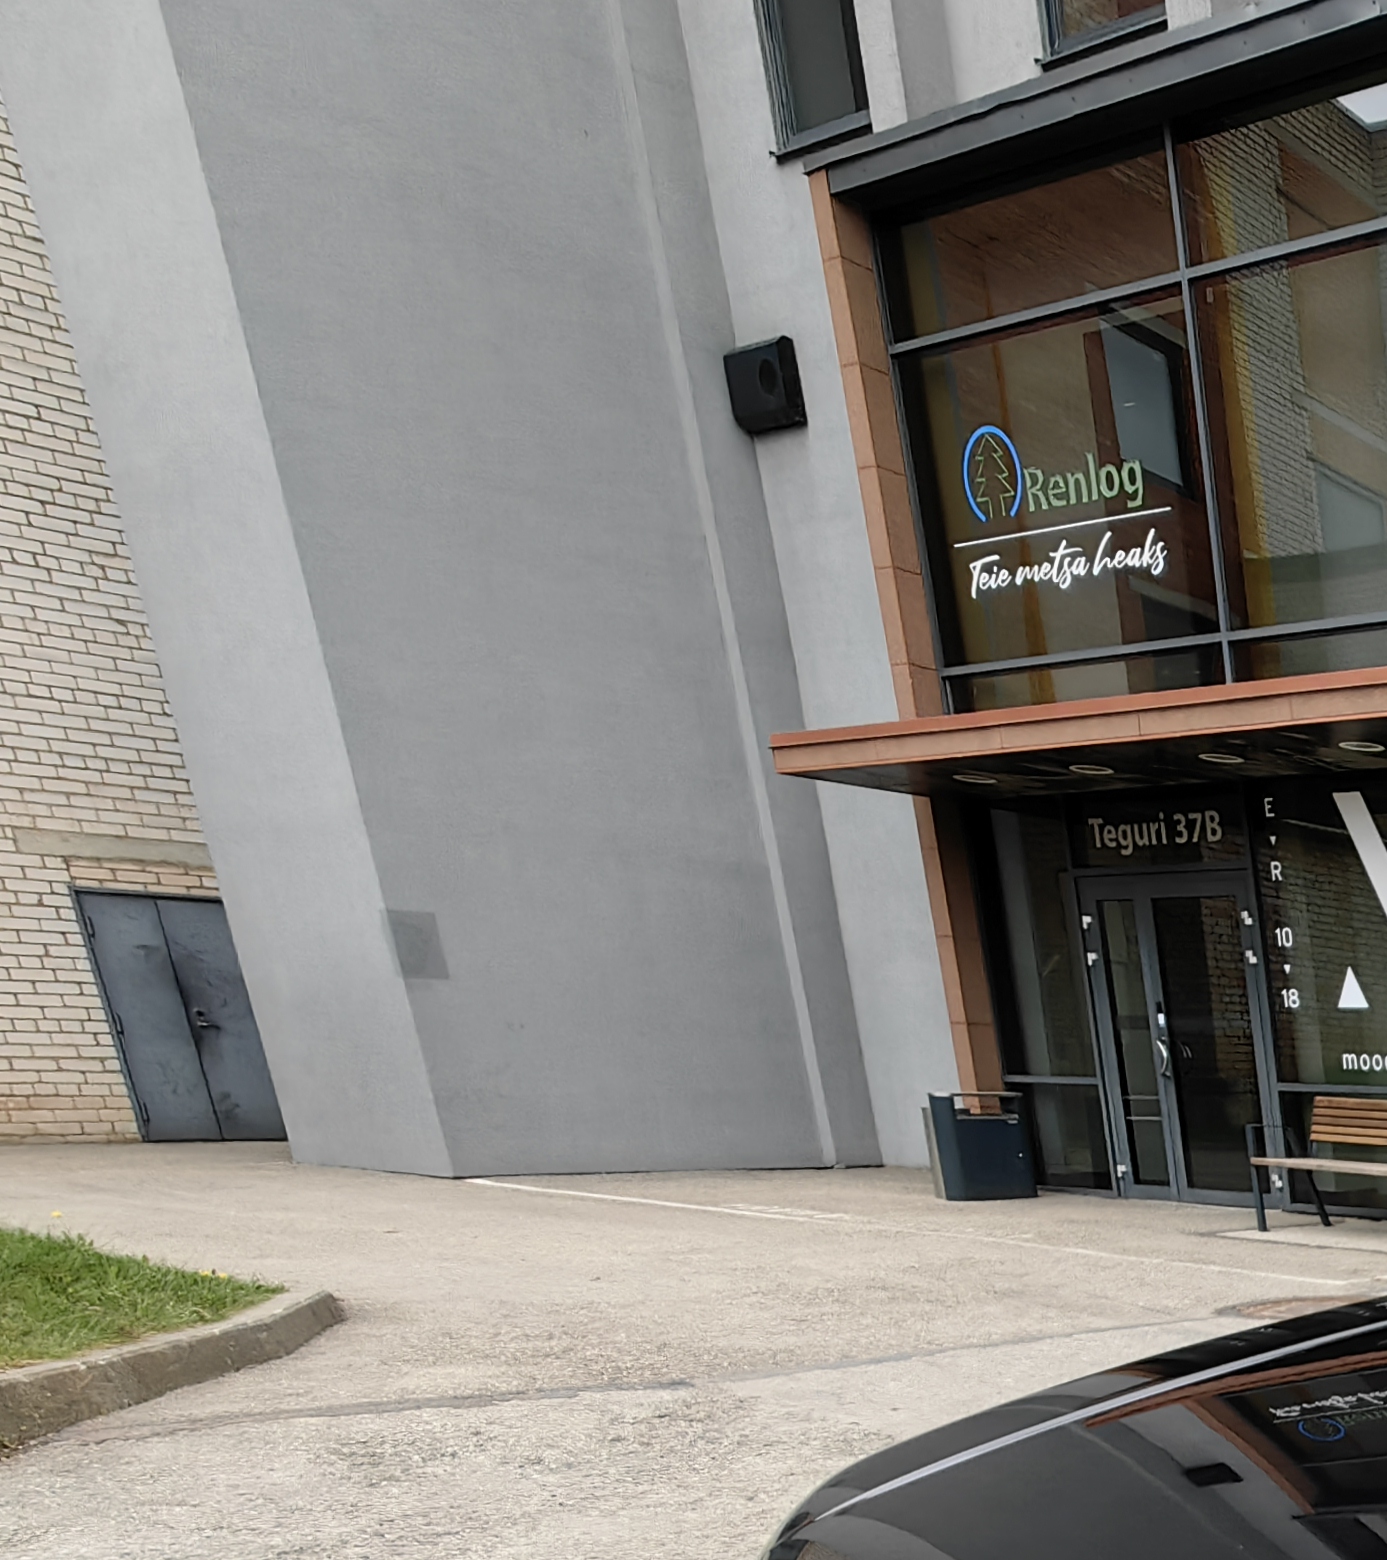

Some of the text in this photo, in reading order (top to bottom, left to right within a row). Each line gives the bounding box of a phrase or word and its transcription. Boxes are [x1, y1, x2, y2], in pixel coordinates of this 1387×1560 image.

[1022, 451, 1144, 513] Renlog
[969, 528, 1168, 599] Teie metsa heaks
[1263, 797, 1276, 818] E
[1087, 809, 1223, 856] Teguri 37B
[1269, 861, 1283, 882] R
[1274, 927, 1294, 948] 10
[1280, 988, 1301, 1009] 18
